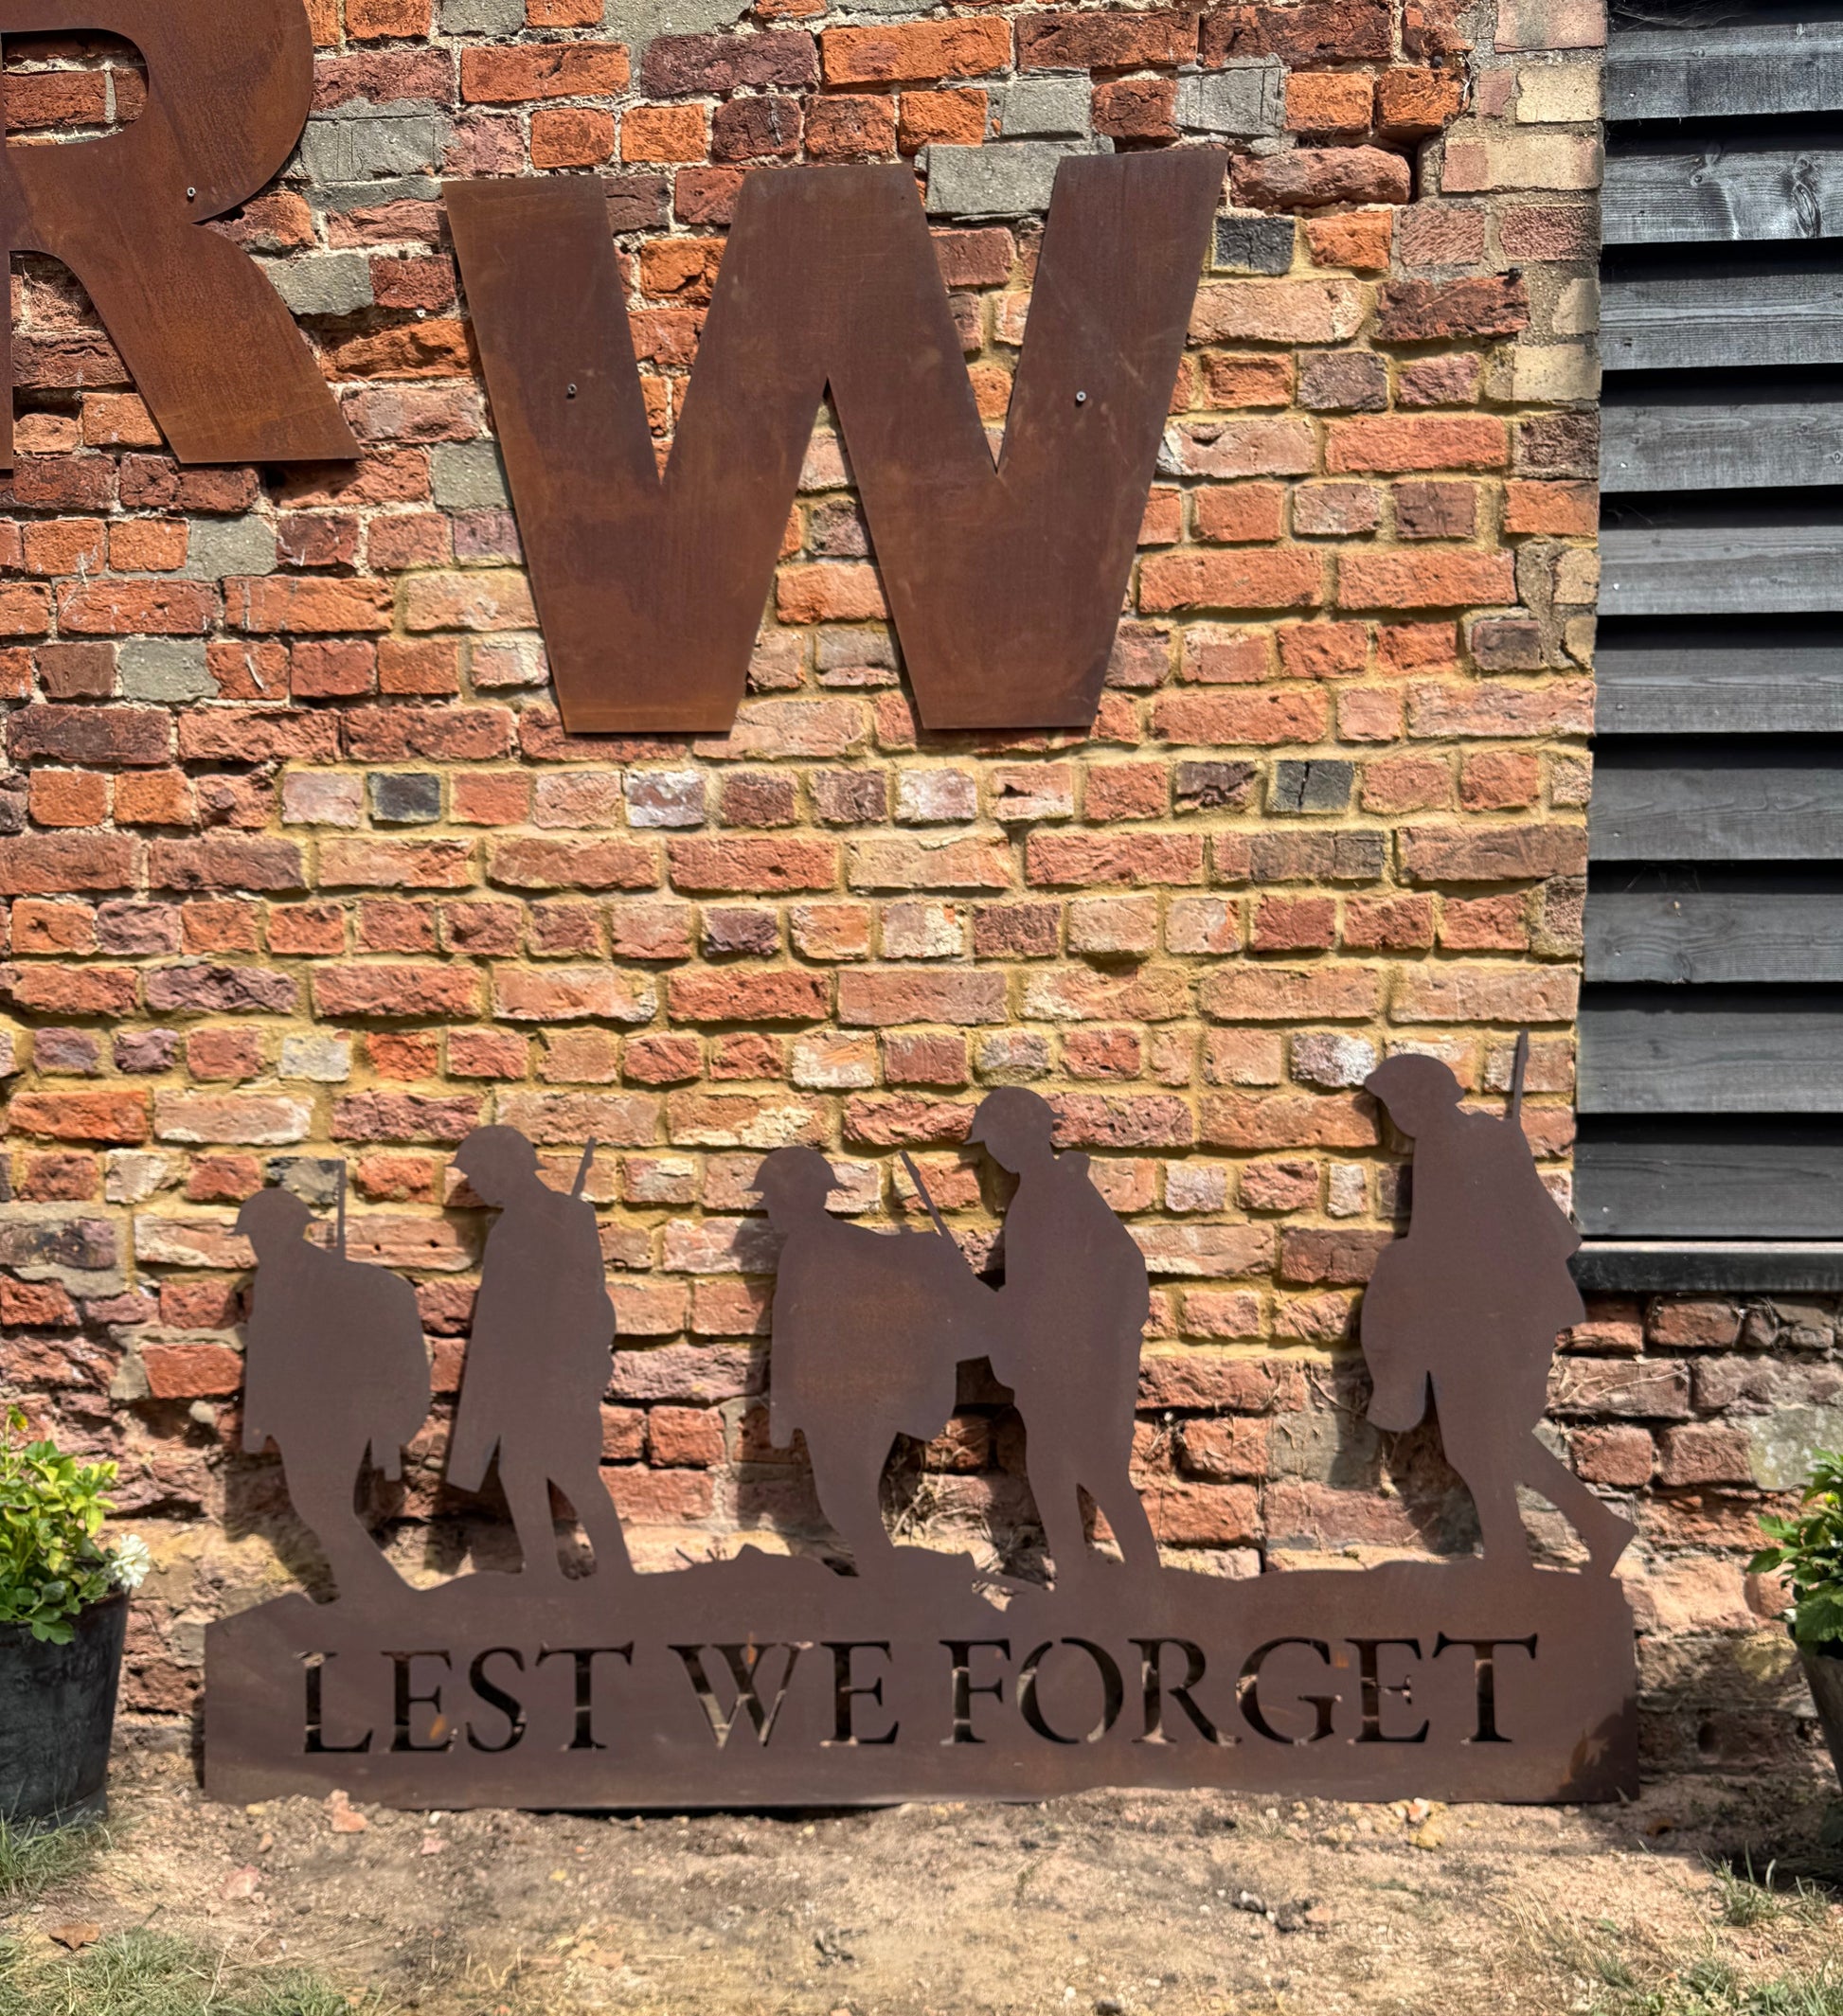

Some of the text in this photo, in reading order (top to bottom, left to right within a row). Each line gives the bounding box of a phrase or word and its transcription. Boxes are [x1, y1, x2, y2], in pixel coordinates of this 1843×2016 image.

[294, 1631, 1539, 1754] LEST WE FORGET
